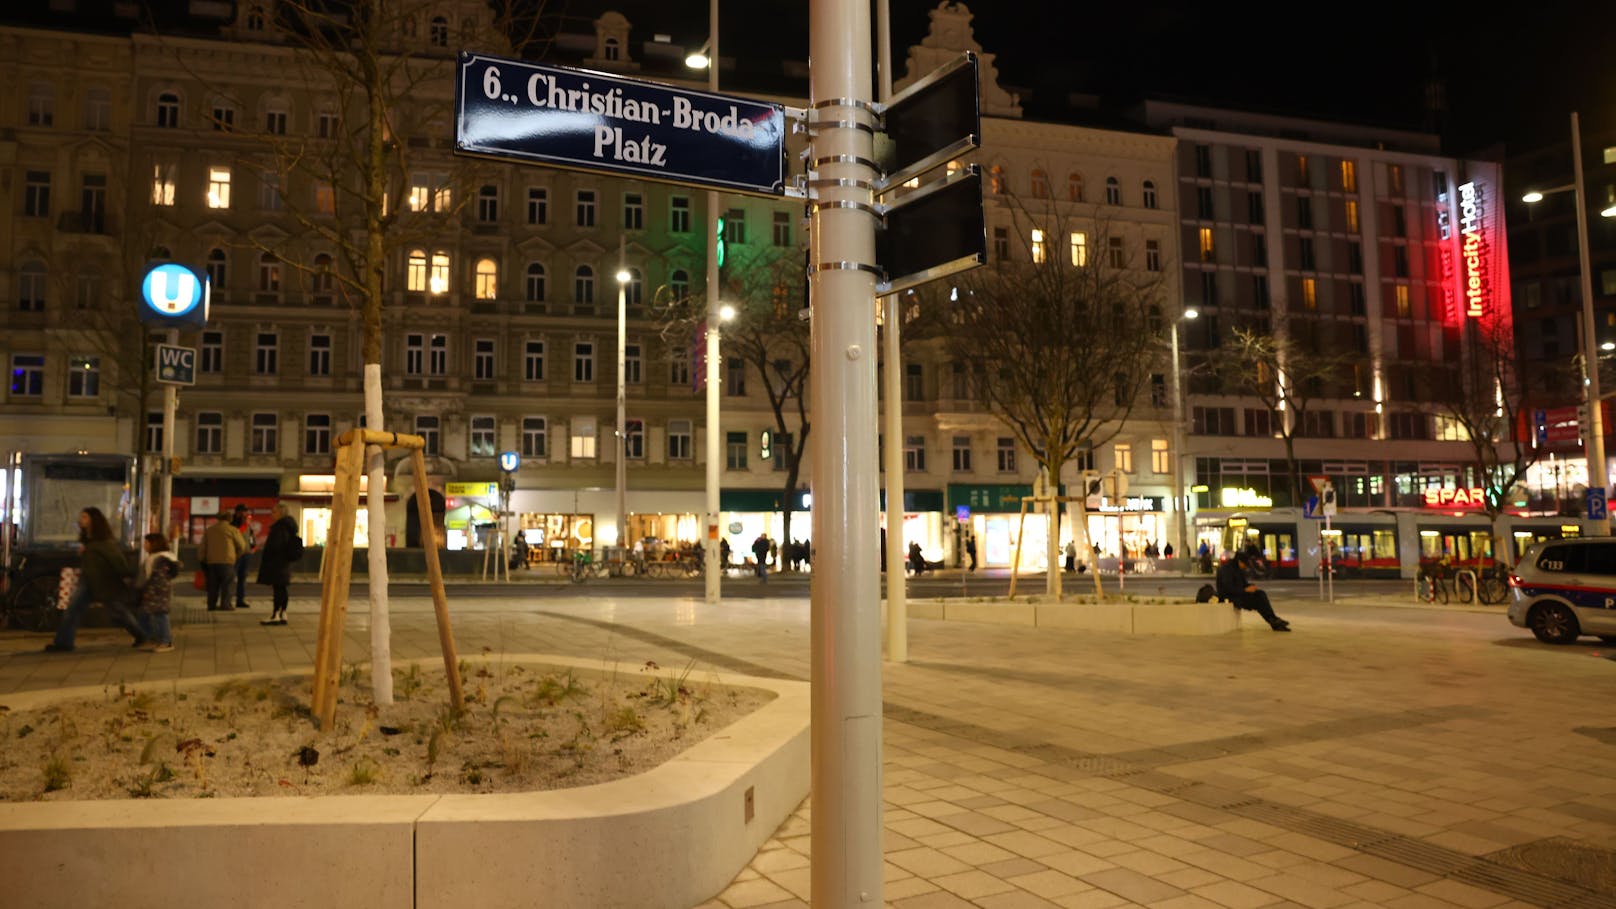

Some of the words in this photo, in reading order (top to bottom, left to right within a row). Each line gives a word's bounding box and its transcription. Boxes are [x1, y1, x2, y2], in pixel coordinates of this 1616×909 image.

[483, 66, 518, 105] 6.,
[527, 73, 754, 138] Christian-Broda
[593, 125, 667, 167] Platz
[150, 271, 195, 313] U
[162, 348, 193, 368] WC
[501, 454, 516, 470] U
[1425, 487, 1485, 505] SPAR
[1591, 498, 1603, 516] P
